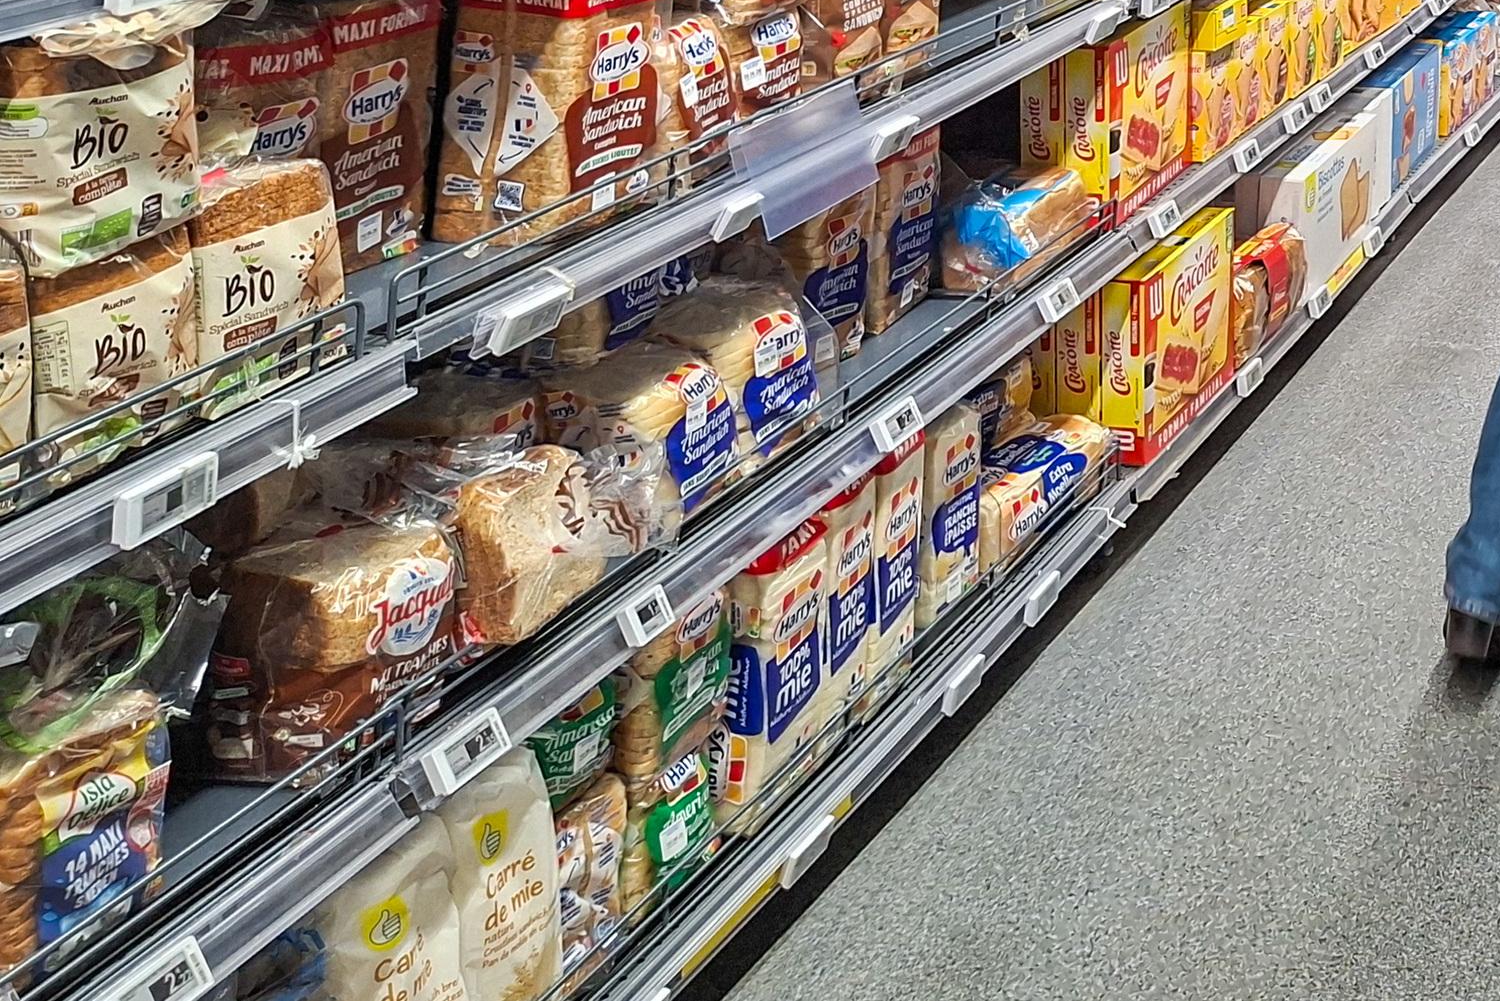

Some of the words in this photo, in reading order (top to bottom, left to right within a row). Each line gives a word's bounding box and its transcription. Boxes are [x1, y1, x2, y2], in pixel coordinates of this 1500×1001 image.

[333, 19, 377, 46] MAXI
[757, 13, 797, 42] Harrys
[842, 8, 883, 33] SANDWICH
[596, 43, 640, 75] Harrys
[1115, 48, 1128, 87] LU
[88, 93, 129, 106] Auchan
[351, 83, 404, 118] Harrys
[582, 96, 647, 129] American
[71, 122, 129, 170] BIO
[582, 113, 643, 145] Sandwich
[1123, 184, 1152, 217] FORMAT
[1151, 159, 1185, 191] FAMILIAL
[233, 239, 265, 254] Auchan
[101, 296, 136, 314] Auchan
[222, 268, 275, 317] BIO
[1149, 277, 1162, 321] LU
[209, 316, 243, 335] Spécial
[244, 301, 289, 323] Sandwich
[90, 326, 146, 380] BIO
[225, 329, 275, 350] complète
[760, 362, 812, 403] American
[763, 374, 810, 415] Sandwich
[681, 405, 732, 449] American
[1158, 410, 1189, 449] FORMAT
[1188, 375, 1224, 415] FAMILIAL
[683, 425, 730, 466] Sandwich
[1118, 428, 1136, 452] LU
[944, 452, 976, 483] Harrys
[1048, 461, 1074, 484] Extra
[889, 500, 918, 532] Harrys
[943, 503, 978, 530] TRANCHE
[1013, 504, 1046, 536] Harrys
[840, 534, 872, 570] Harrys
[889, 550, 913, 578] 100%
[839, 583, 865, 618] 100%
[885, 569, 913, 608] mie
[682, 598, 722, 636] Harrys
[778, 592, 820, 640] Harrys
[836, 601, 867, 648] mie
[779, 643, 811, 685] 100%
[776, 662, 813, 715] mie
[79, 773, 116, 805] Isla
[66, 787, 129, 831] Délice
[65, 852, 87, 876] 14
[91, 822, 125, 864] MAXI
[485, 848, 536, 901] Carré
[484, 900, 509, 933] de
[511, 879, 545, 915] mie
